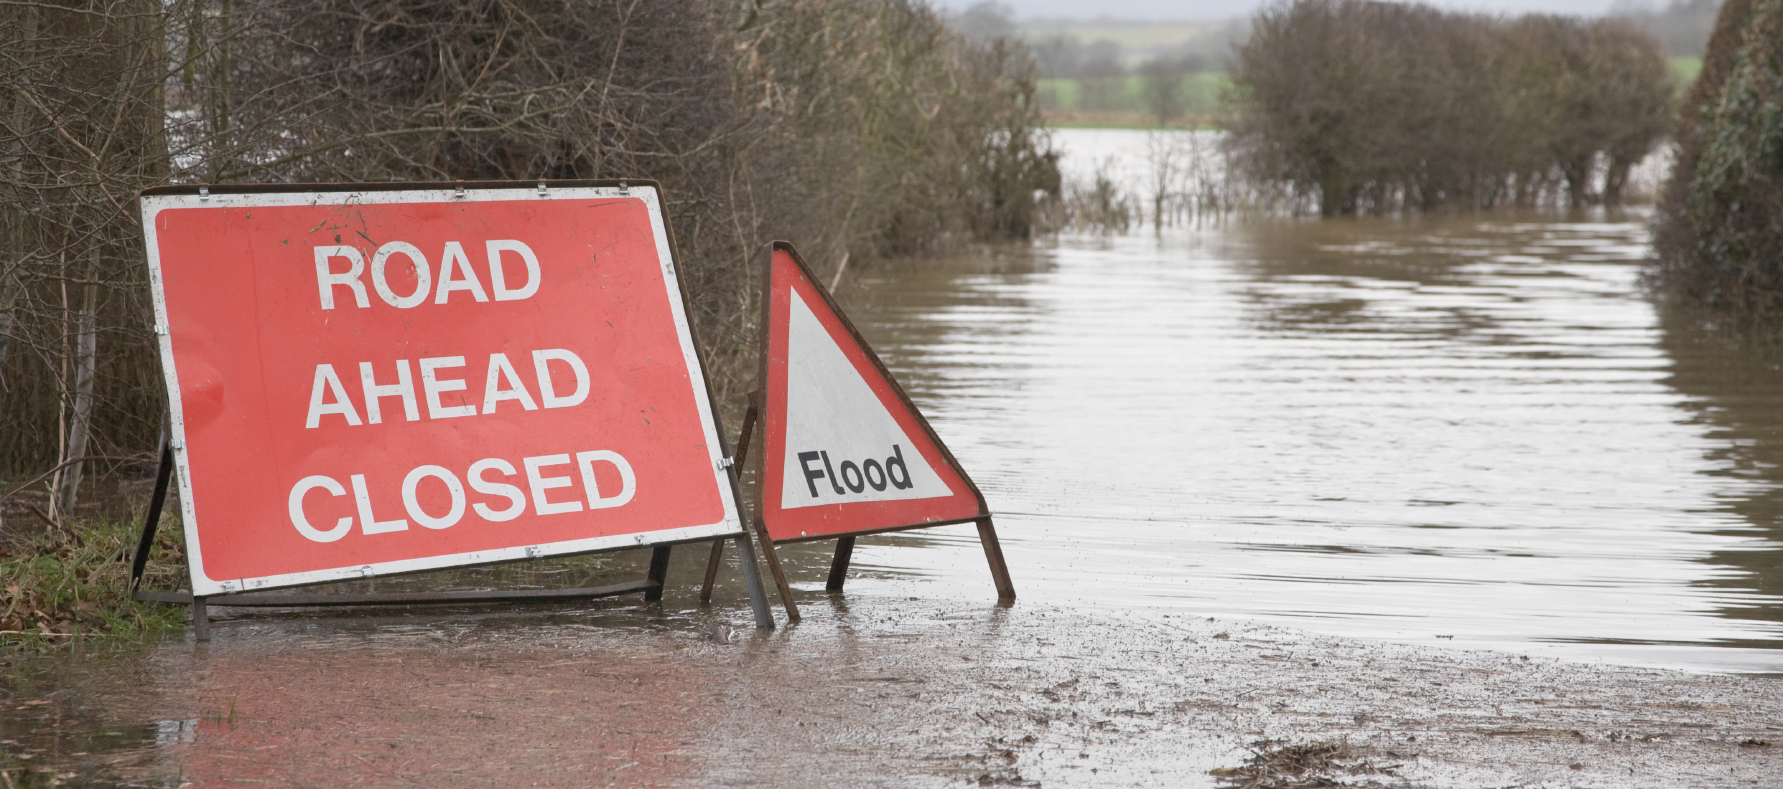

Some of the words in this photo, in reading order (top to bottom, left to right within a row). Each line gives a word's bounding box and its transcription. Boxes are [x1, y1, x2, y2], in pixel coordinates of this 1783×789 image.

[314, 239, 541, 309] ROAD
[306, 348, 591, 429] AHEAD
[288, 450, 637, 543] CLOSED
[797, 444, 914, 498] Flood
